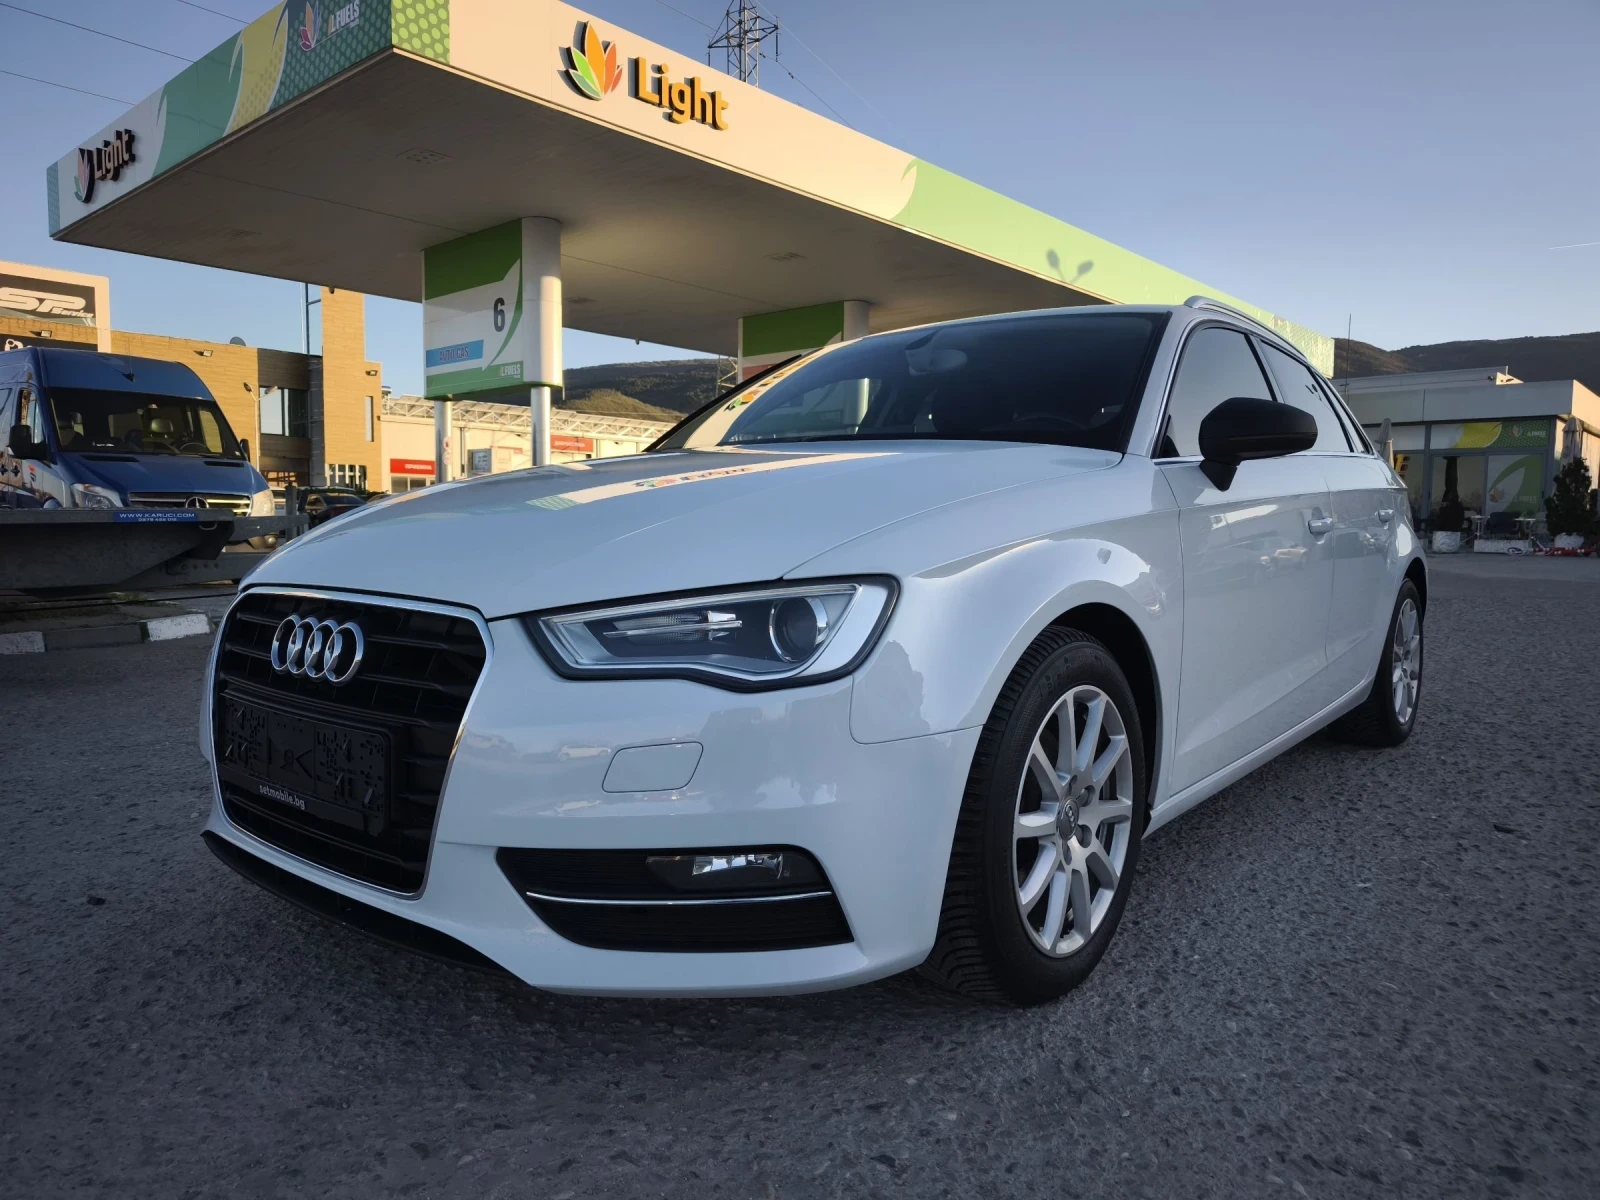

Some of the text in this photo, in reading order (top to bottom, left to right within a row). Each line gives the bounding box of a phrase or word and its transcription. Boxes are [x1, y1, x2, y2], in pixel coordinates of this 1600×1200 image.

[634, 56, 729, 131] Light
[93, 128, 135, 182] Light
[50, 307, 94, 318] Service
[493, 297, 506, 333] 6
[439, 346, 469, 363] AUTO GAS
[259, 784, 306, 811] setmobile.bg
